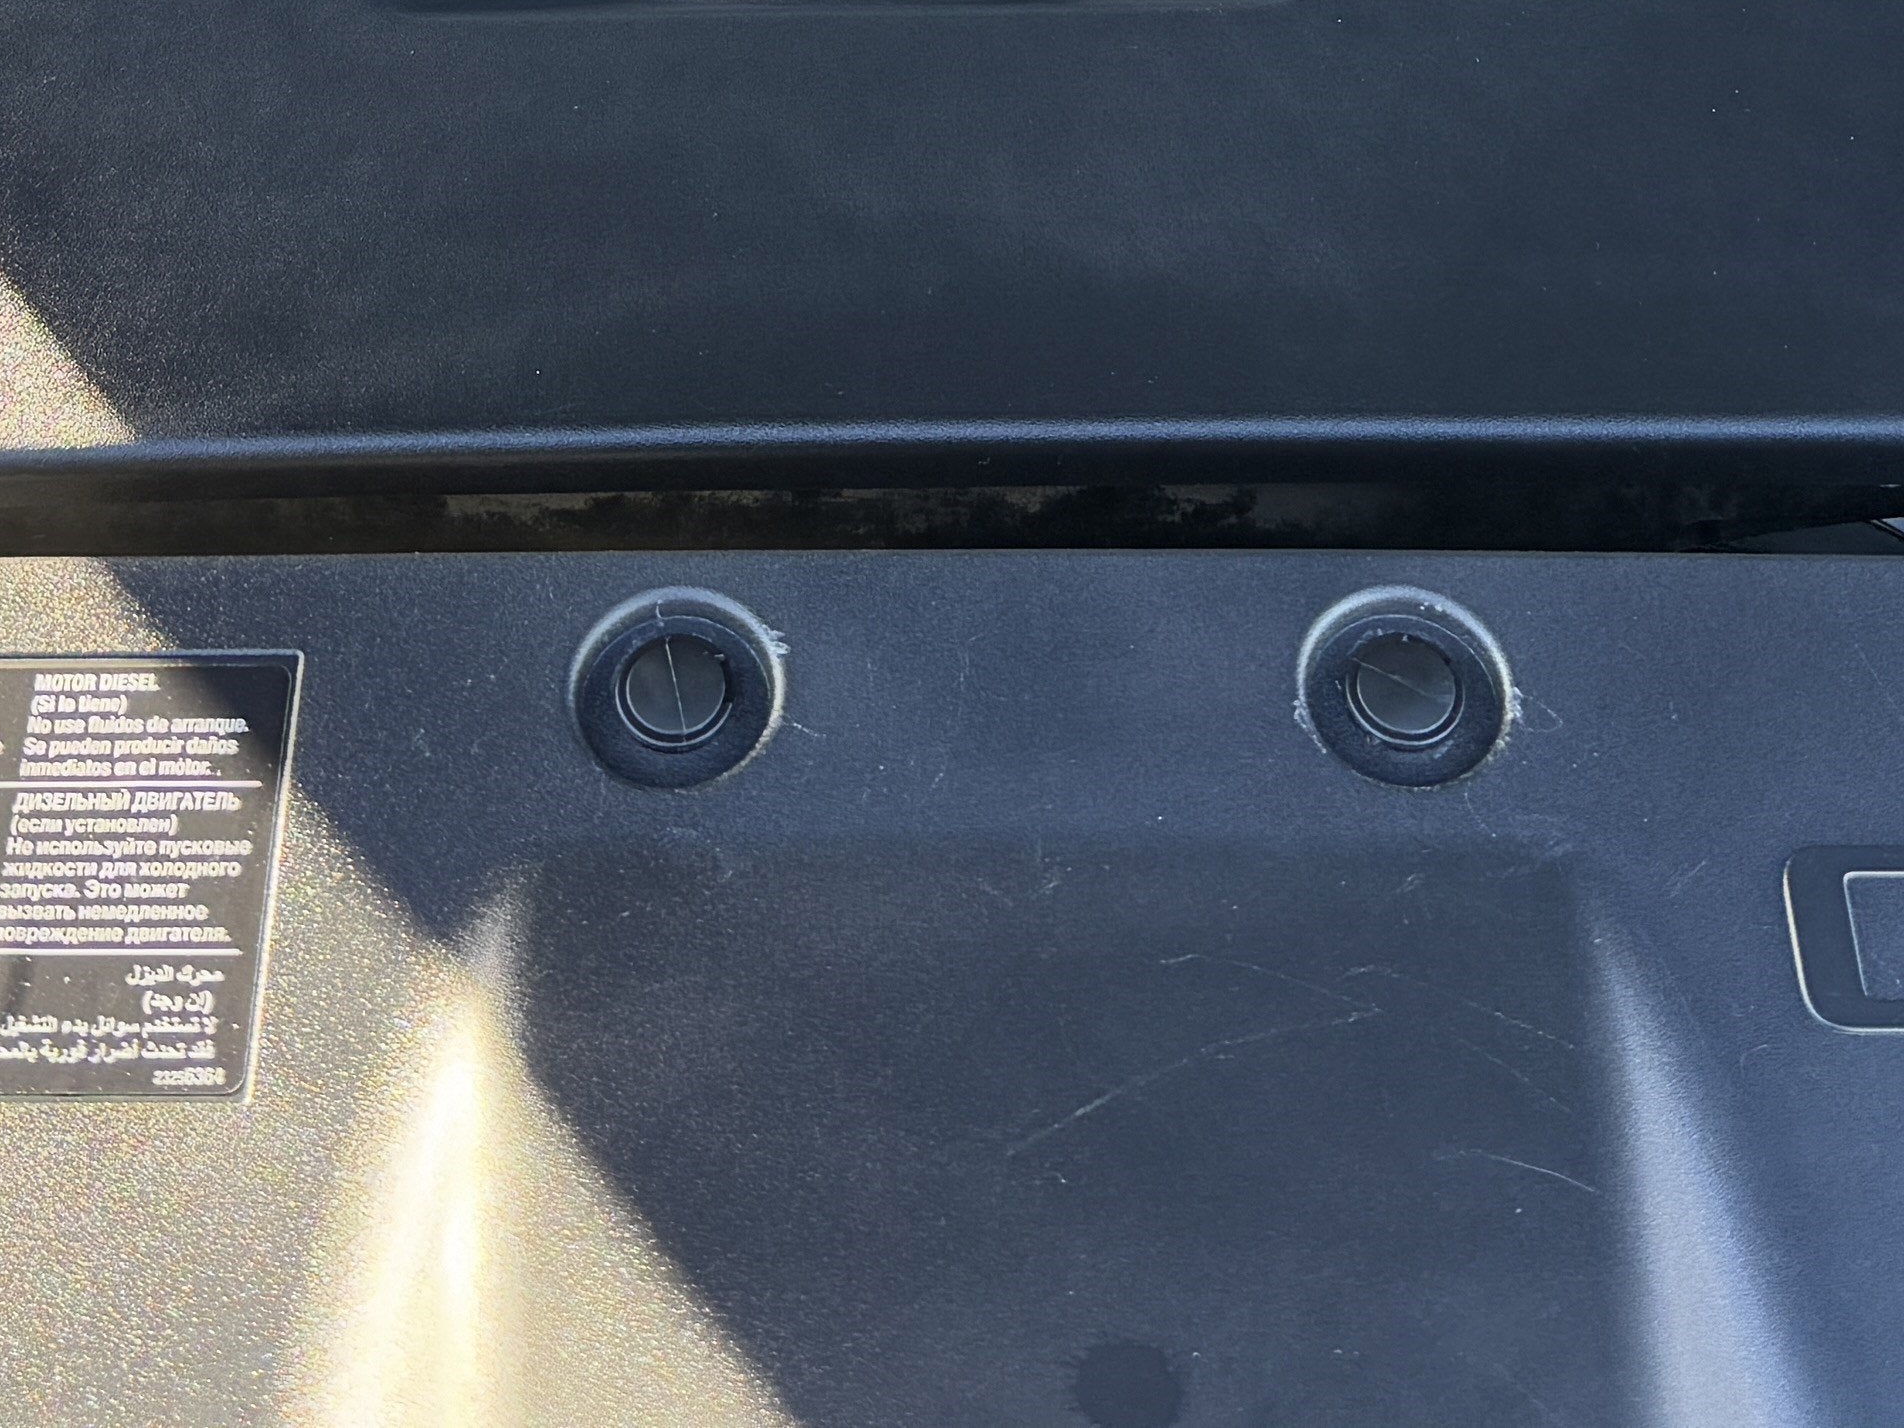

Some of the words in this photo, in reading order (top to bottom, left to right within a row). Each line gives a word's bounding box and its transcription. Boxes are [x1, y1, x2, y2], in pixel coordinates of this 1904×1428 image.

[34, 673, 97, 691] MOTOR
[99, 673, 161, 691] DIESEL
[30, 694, 55, 715] (Si
[78, 694, 127, 715] tiene)
[27, 716, 52, 734] No
[54, 718, 86, 734] use
[87, 715, 144, 734] fluidos
[146, 715, 169, 733] de
[171, 717, 250, 735] arranque.
[23, 737, 48, 756] Se
[49, 738, 112, 758] pueden
[114, 737, 185, 758] producir
[186, 736, 240, 755] daños
[20, 759, 112, 777] inmediatos
[114, 761, 137, 776] en
[139, 758, 156, 776] el
[12, 789, 131, 813] ДИЗЕЛЬНЫЙ
[131, 792, 243, 813] ДВИГАТЕЛЬ
[10, 814, 63, 835] (если
[64, 814, 179, 836] установлен)
[6, 837, 34, 856] Не
[36, 837, 157, 858] используйте
[159, 840, 253, 858] пусковые
[1, 861, 97, 879] жидкости
[99, 861, 137, 879] для
[139, 861, 243, 879] холодного
[83, 879, 122, 899] Это
[124, 883, 190, 899] может
[78, 904, 209, 922] немедленное
[125, 926, 232, 944] двигателя.
